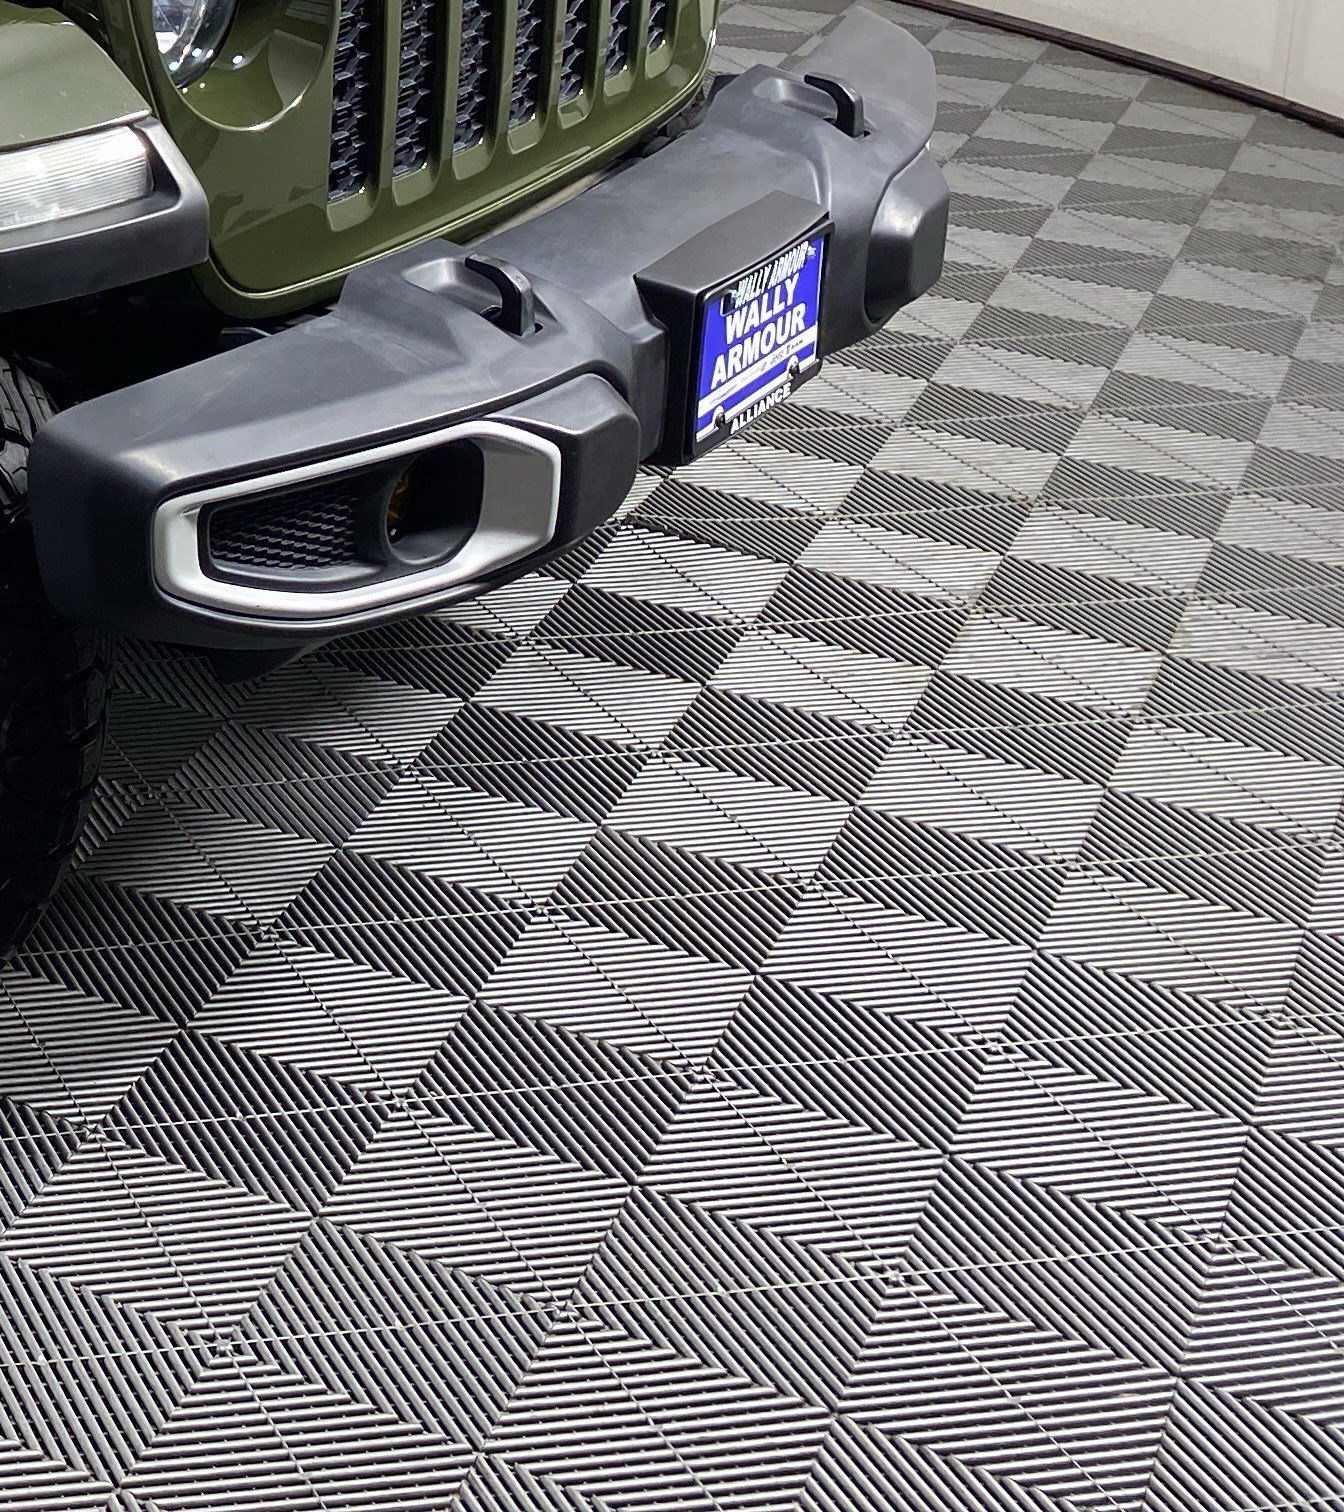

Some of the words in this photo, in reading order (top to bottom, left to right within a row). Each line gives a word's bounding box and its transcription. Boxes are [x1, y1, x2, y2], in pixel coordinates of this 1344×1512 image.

[725, 273, 800, 344] WALLY
[710, 302, 806, 390] ARMOUR
[730, 382, 791, 435] ALLIANCE
